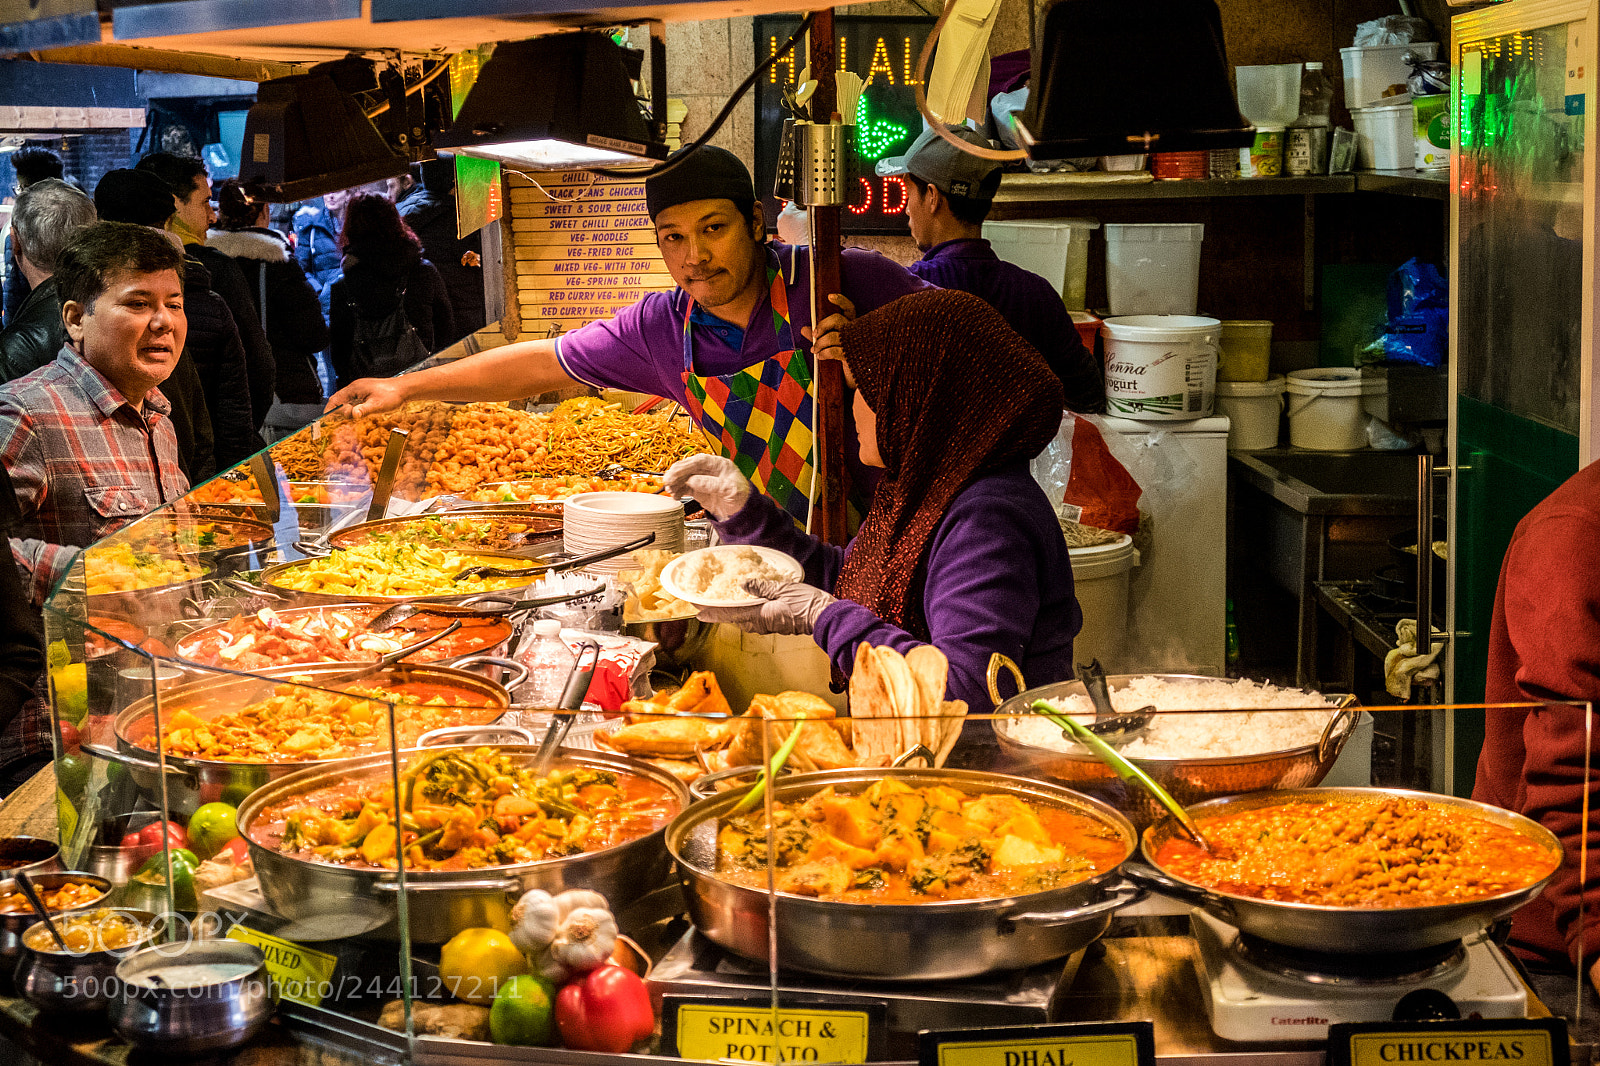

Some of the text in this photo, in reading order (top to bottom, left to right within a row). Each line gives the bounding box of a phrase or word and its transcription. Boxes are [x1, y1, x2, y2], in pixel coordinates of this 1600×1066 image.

[770, 36, 925, 85] HLAL
[562, 172, 589, 183] CHILLI
[549, 189, 574, 199] BLACK
[609, 186, 645, 197] CHICKEN
[544, 204, 573, 215] SWEET
[576, 204, 584, 213] &
[588, 203, 612, 213] SOUR
[549, 218, 649, 229] SWEET CHILLI CHICKEN
[615, 247, 634, 256] RICE
[553, 263, 580, 272] MIXED
[630, 261, 651, 271] TOFU
[622, 276, 642, 285] ROLL
[549, 291, 565, 300] RED
[567, 291, 595, 300] CURRY
[541, 307, 557, 316] RED
[560, 307, 587, 316] CURRY
[1271, 1016, 1329, 1026] Caterlite
[708, 1017, 837, 1039] SPINACH &
[1379, 1041, 1525, 1062] CHICKPEAS
[1004, 1049, 1074, 1066] DHAL
